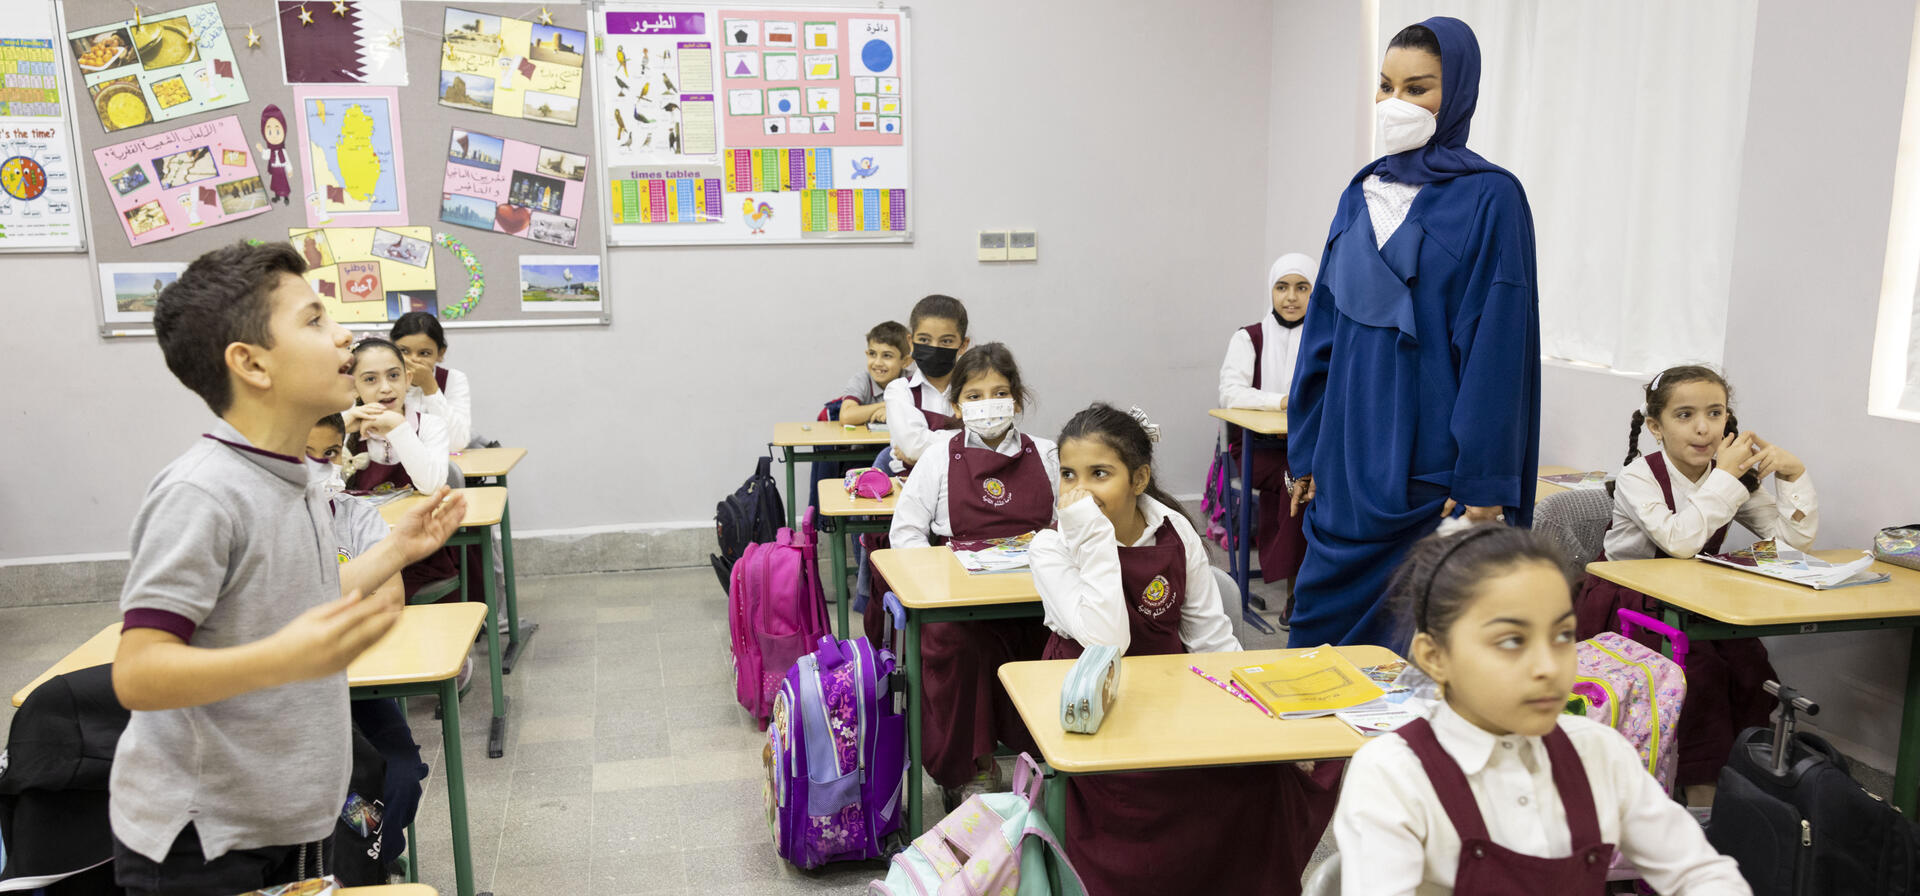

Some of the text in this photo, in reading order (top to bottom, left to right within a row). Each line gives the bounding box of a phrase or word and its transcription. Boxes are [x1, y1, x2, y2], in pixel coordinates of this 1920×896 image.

[630, 14, 676, 32] الطيور
[866, 23, 889, 34] دائرة
[13, 128, 29, 139] the
[32, 128, 56, 139] time?
[630, 170, 701, 179] times tables
